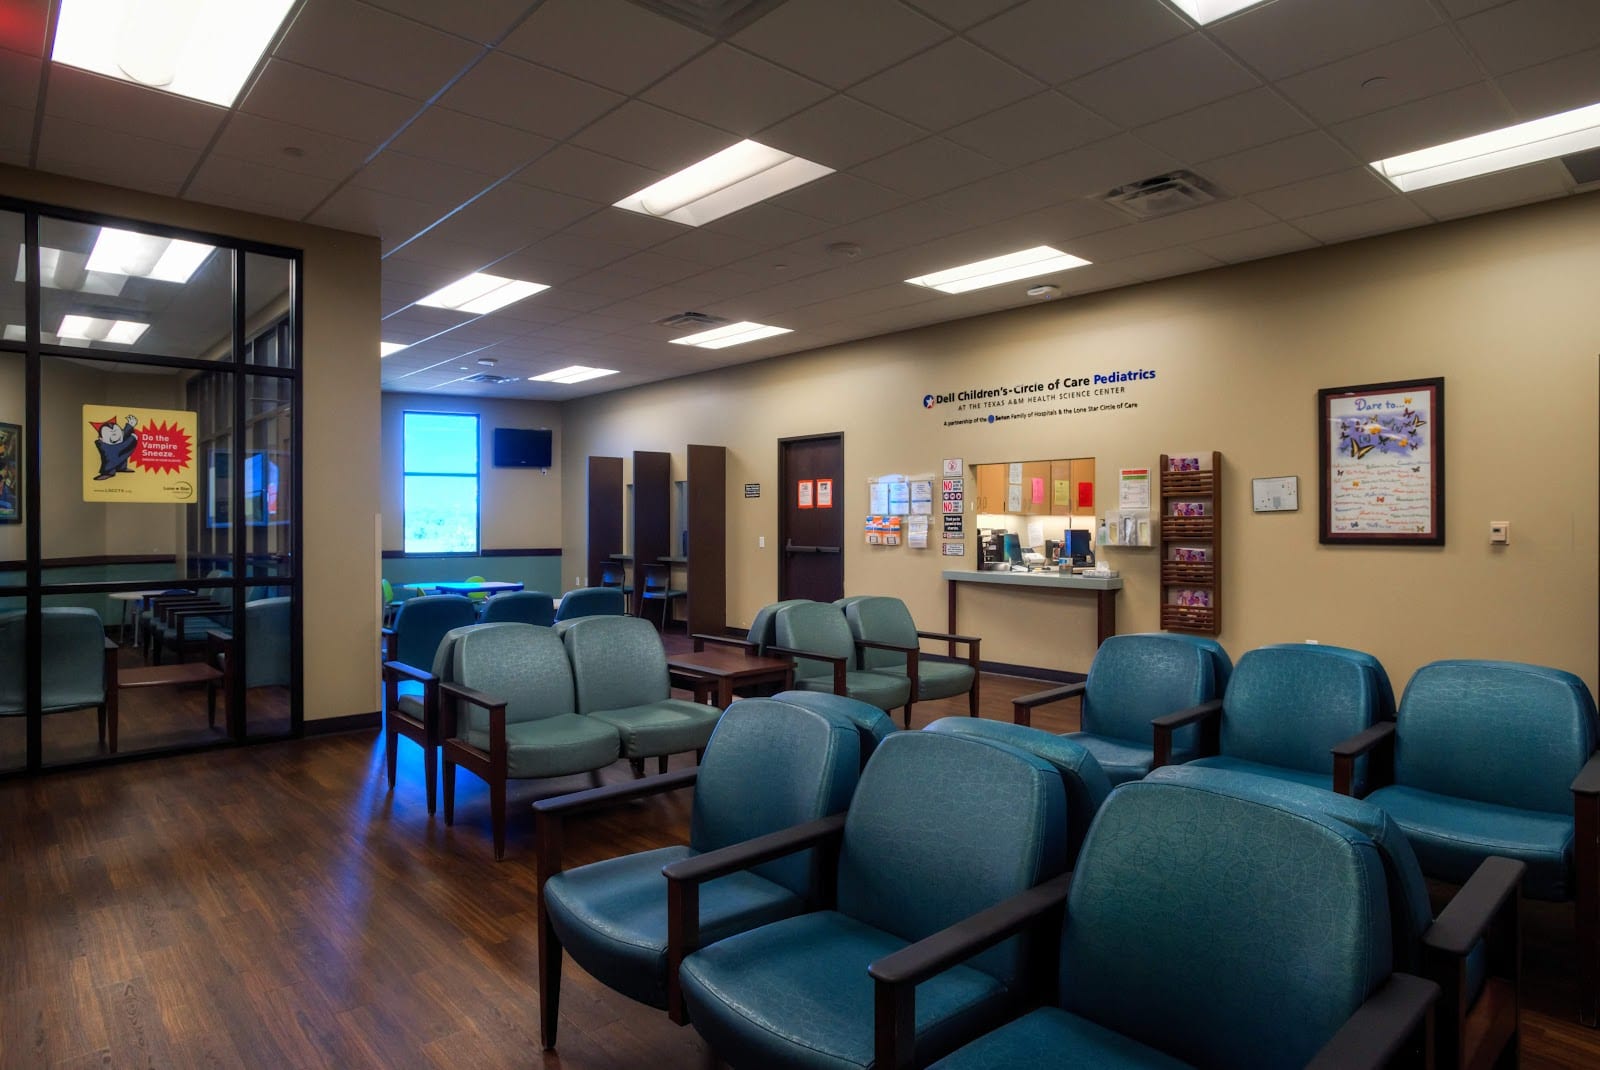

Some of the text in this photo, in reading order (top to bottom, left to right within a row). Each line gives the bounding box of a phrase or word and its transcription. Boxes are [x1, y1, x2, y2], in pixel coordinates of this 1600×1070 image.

[936, 393, 955, 404] Dell
[1047, 378, 1060, 391] of
[1063, 377, 1090, 388] Care
[1093, 369, 1156, 385] Pediatrics
[969, 402, 981, 410] THE
[984, 399, 1005, 408] TEXAS
[1007, 397, 1024, 405] A&M
[1027, 393, 1056, 403] HEALTH
[1059, 390, 1091, 400] SCIENCE
[1094, 386, 1125, 396] CENTER
[1088, 405, 1099, 413] Star
[1100, 403, 1116, 411] Circle
[1124, 401, 1138, 409] Care
[1354, 398, 1382, 411] Dare
[142, 433, 169, 442] Do the
[141, 441, 178, 451] Vampire
[142, 449, 176, 458] Sneeze.
[943, 480, 953, 491] NO
[943, 501, 953, 512] NO
